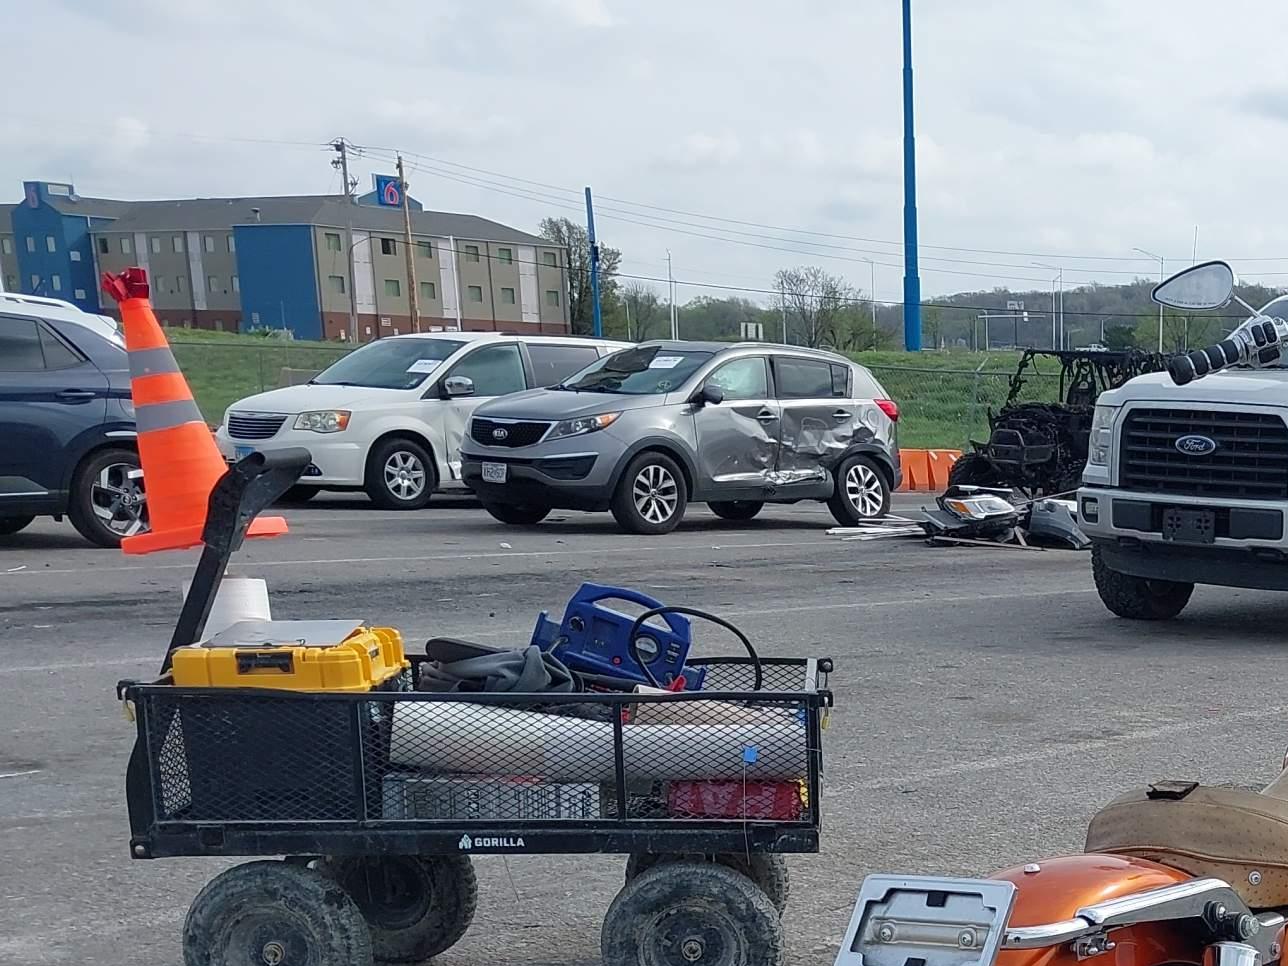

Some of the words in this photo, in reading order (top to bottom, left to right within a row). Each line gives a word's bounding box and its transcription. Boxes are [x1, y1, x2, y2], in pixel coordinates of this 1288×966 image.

[385, 181, 399, 204] 6
[1184, 439, 1205, 450] Ford
[474, 838, 525, 846] GORILLA
